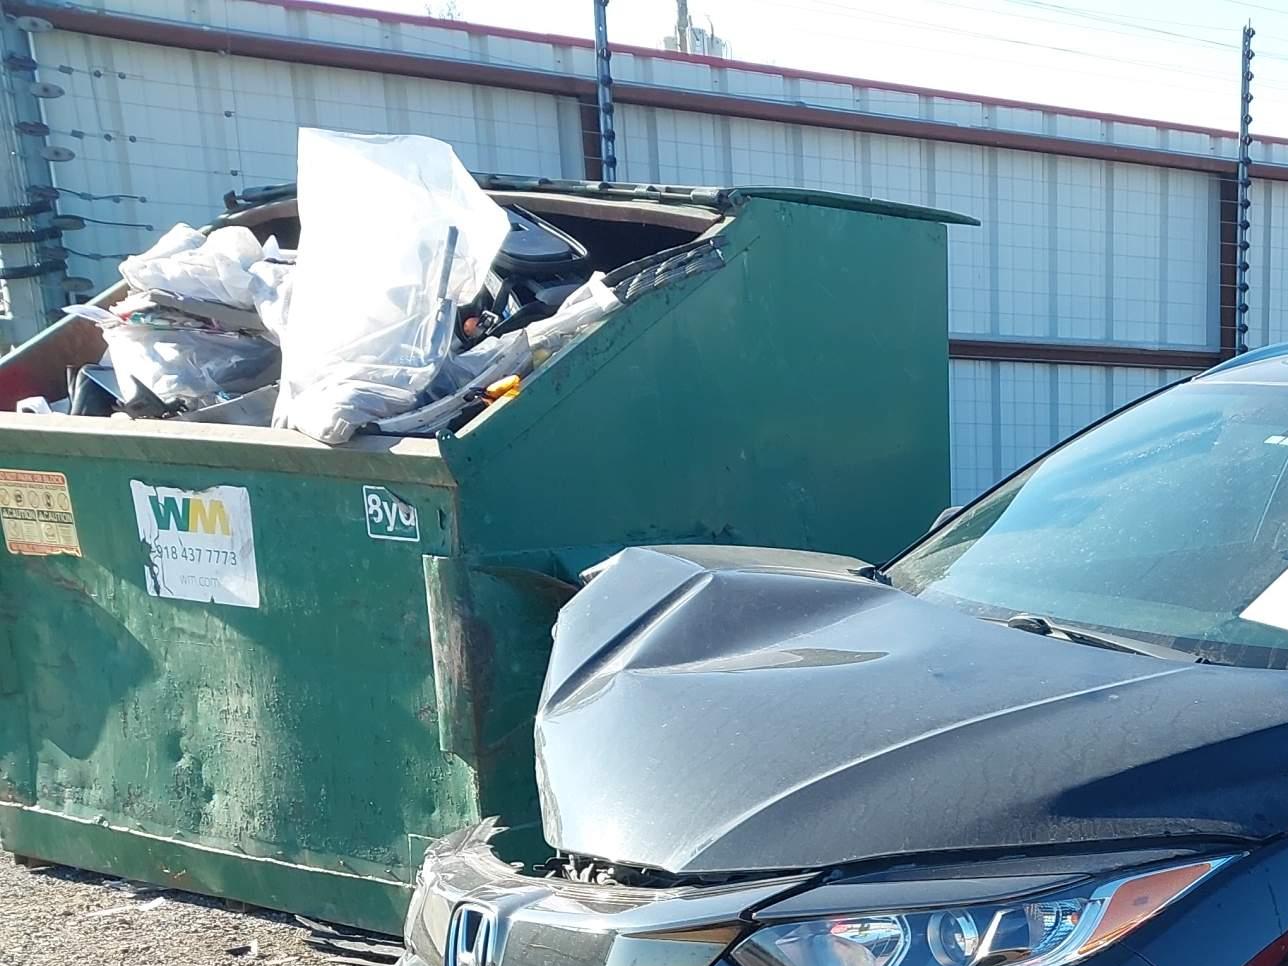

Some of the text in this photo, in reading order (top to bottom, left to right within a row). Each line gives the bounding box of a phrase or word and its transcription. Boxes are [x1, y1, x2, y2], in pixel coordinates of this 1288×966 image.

[148, 495, 231, 536] WM
[181, 547, 202, 562] 437
[204, 549, 238, 566] 7773
